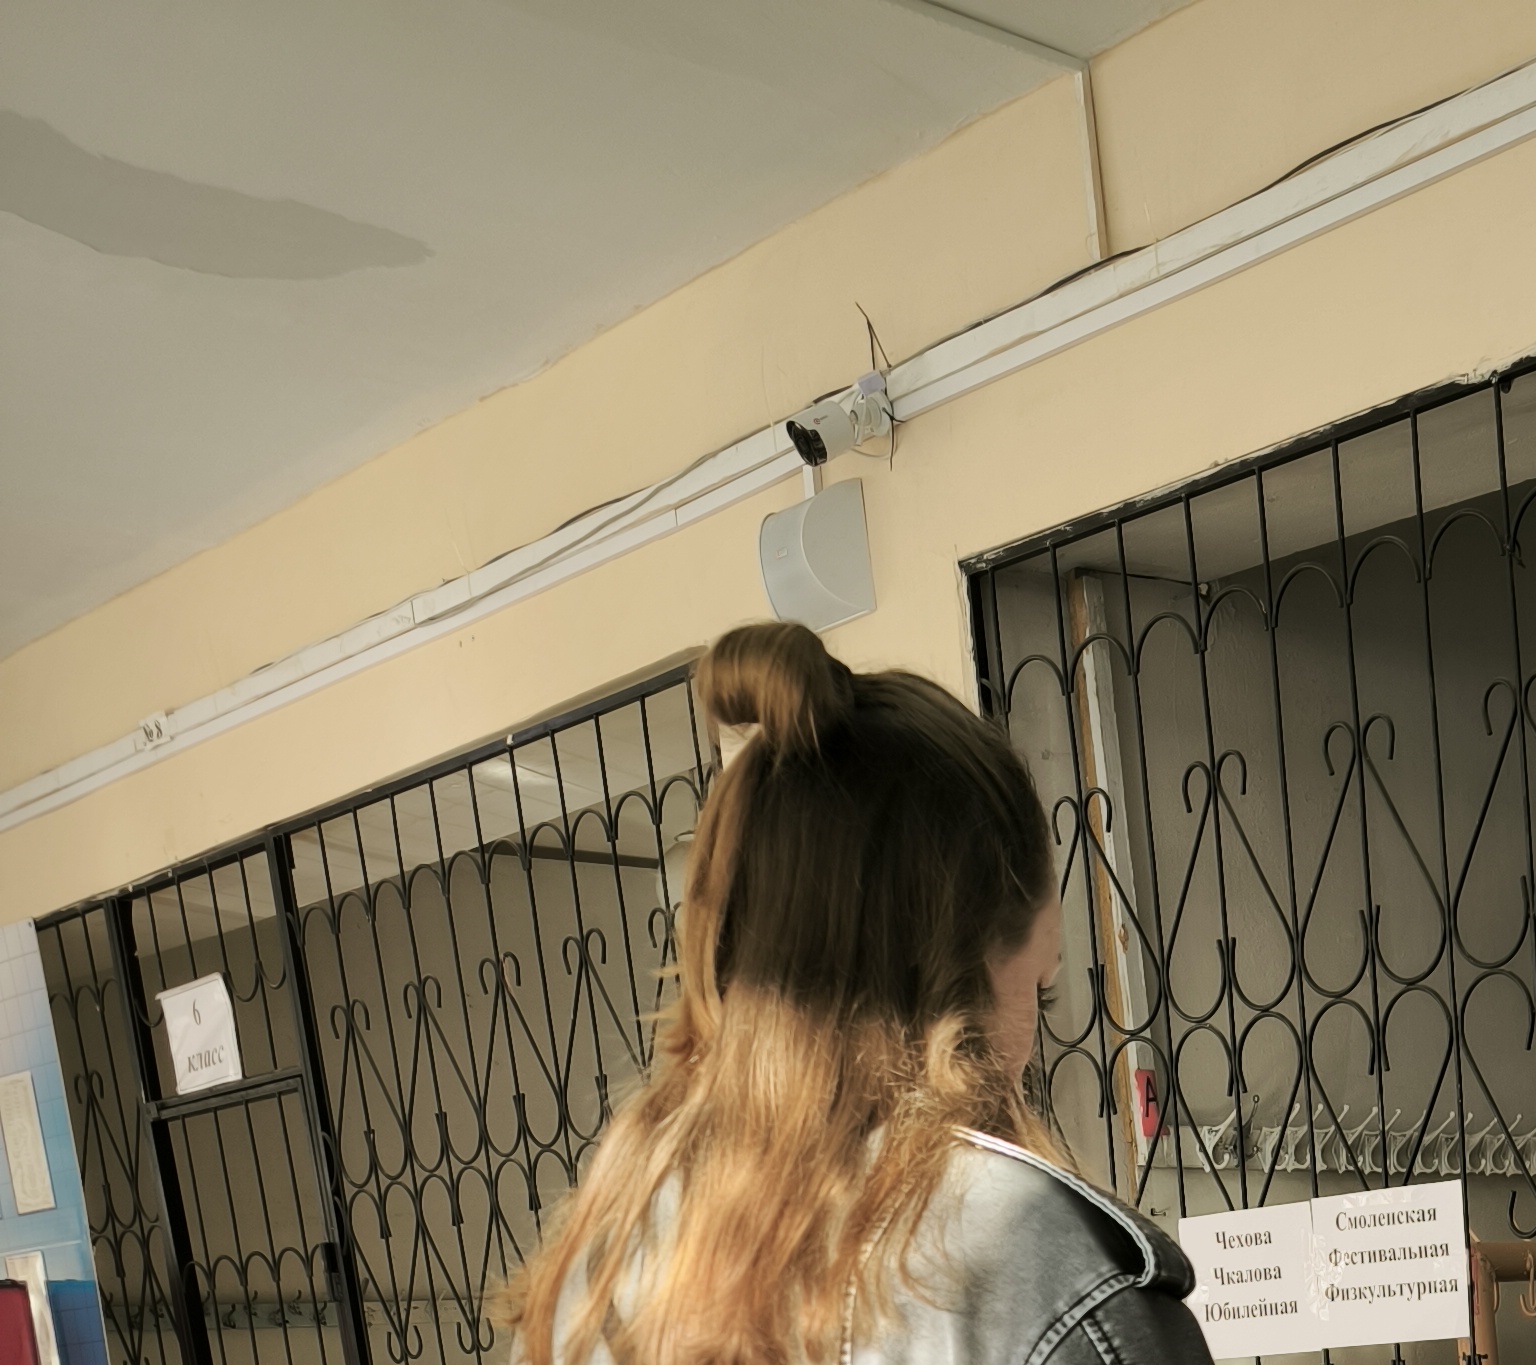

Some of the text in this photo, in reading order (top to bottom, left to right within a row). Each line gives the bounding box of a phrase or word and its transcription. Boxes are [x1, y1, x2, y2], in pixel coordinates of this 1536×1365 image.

[192, 998, 202, 1026] 6
[187, 1045, 225, 1074] класс
[1335, 1206, 1438, 1232] Смоленская
[1214, 1229, 1273, 1250] Чехова
[1328, 1242, 1450, 1268] Фестивальная
[1213, 1265, 1283, 1287] Чкалова
[1324, 1277, 1460, 1304] Физкультурная
[1204, 1299, 1299, 1323] Юбилейная
